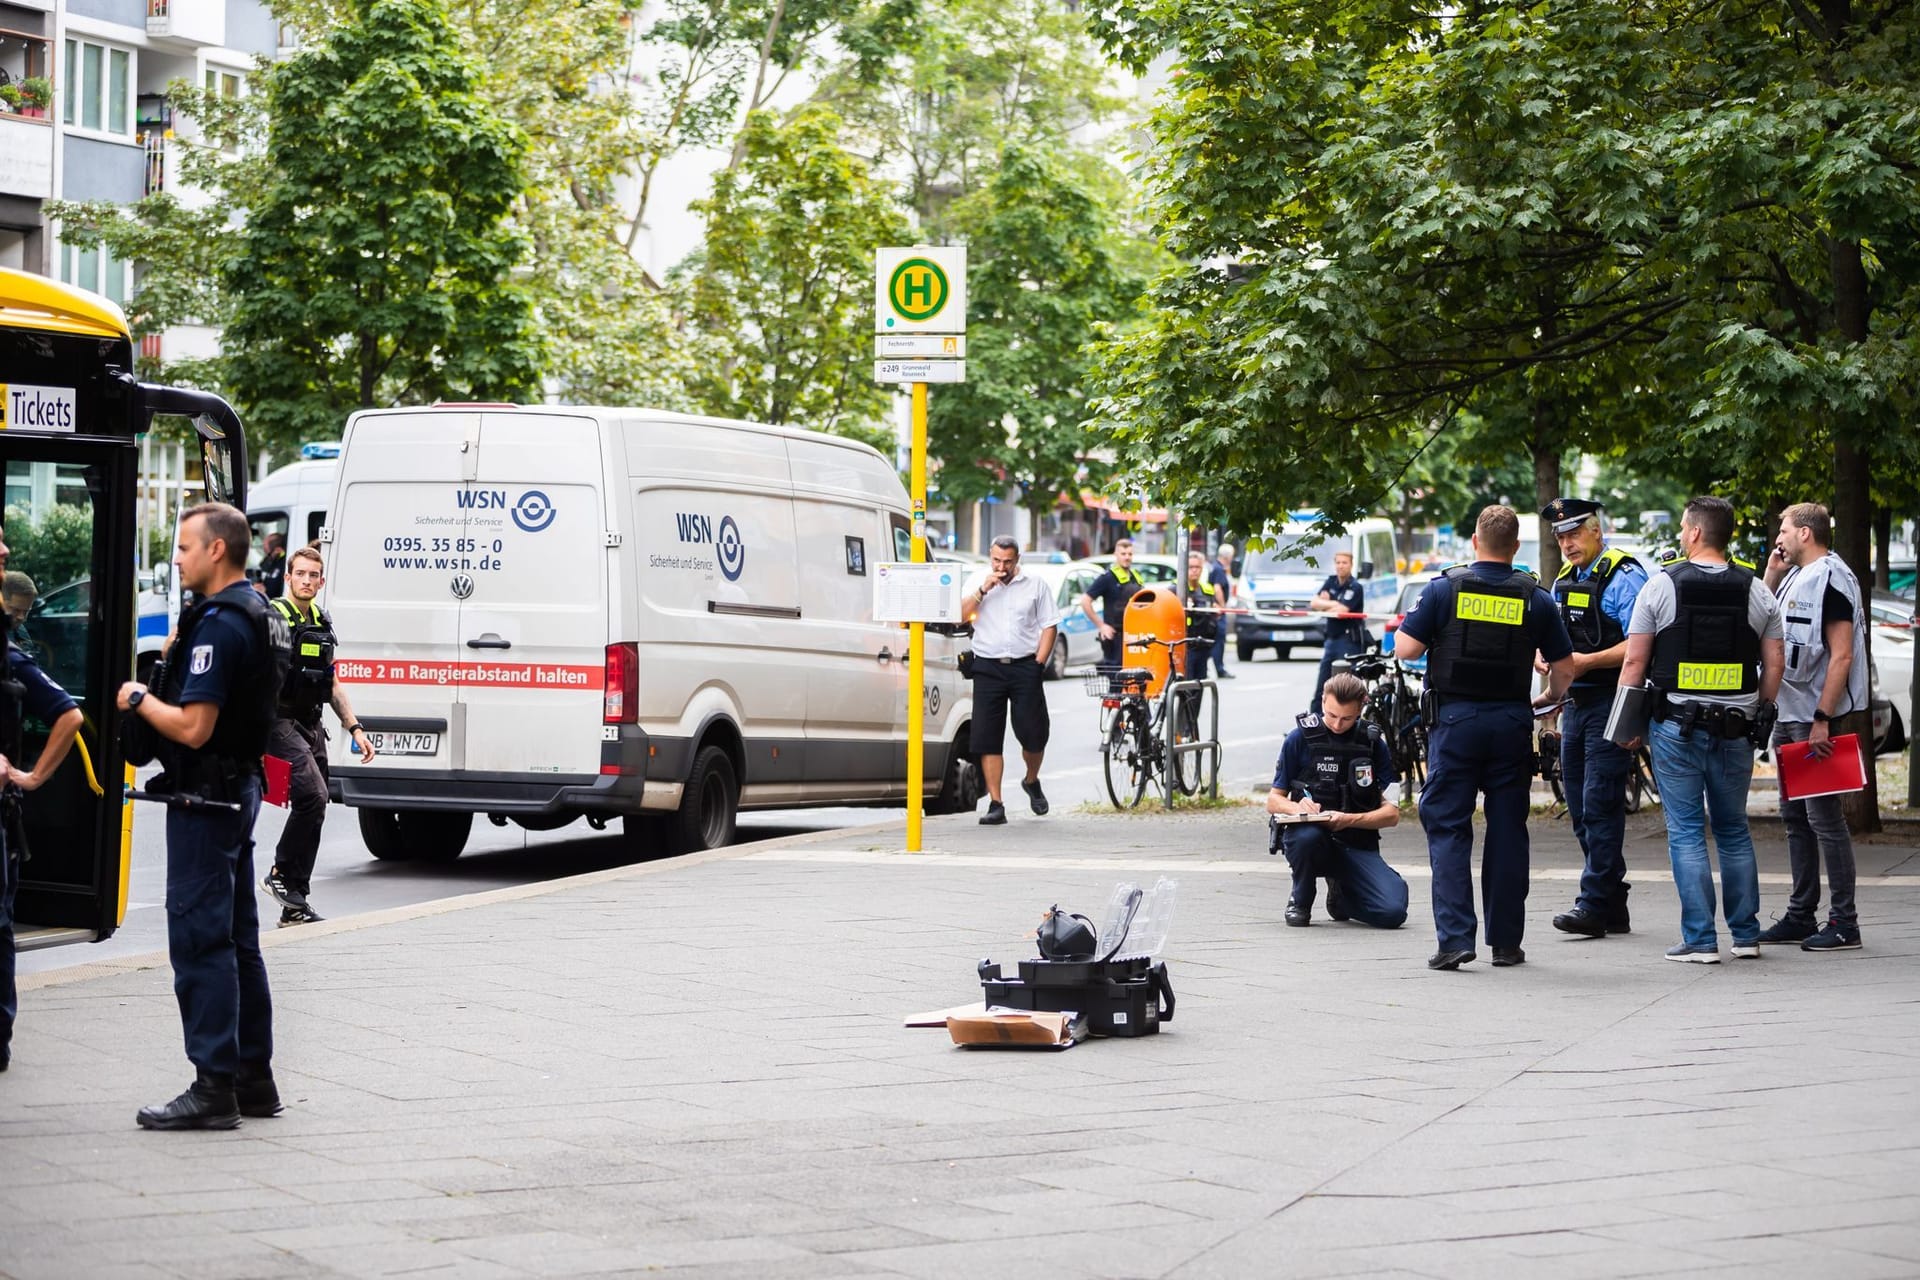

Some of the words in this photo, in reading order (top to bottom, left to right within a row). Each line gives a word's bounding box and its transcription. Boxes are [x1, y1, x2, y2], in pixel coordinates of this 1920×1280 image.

[904, 274, 931, 306] H
[886, 364, 899, 372] 249
[12, 391, 71, 427] Tickets
[457, 490, 506, 509] WSN
[415, 516, 455, 526] Sicherheit
[456, 517, 472, 526] und
[474, 517, 503, 527] Service
[676, 512, 712, 544] WSN
[384, 537, 426, 552] 0395.
[431, 538, 450, 552] 35
[456, 539, 475, 553] 85
[492, 539, 503, 553] 0
[384, 555, 501, 571] www.wsn.de
[650, 554, 680, 569] Sicherheit
[681, 556, 692, 569] und
[693, 557, 713, 571] Service
[1461, 596, 1520, 621] POLIZEI
[338, 663, 372, 679] Bitte
[376, 664, 385, 679] 2
[390, 668, 405, 679] m
[409, 665, 531, 684] Rangierabstand
[536, 666, 587, 684] halten
[1682, 667, 1739, 686] POLIZEI
[393, 734, 411, 750] WN
[414, 735, 431, 750] 70
[1316, 763, 1339, 772] POLIZEI
